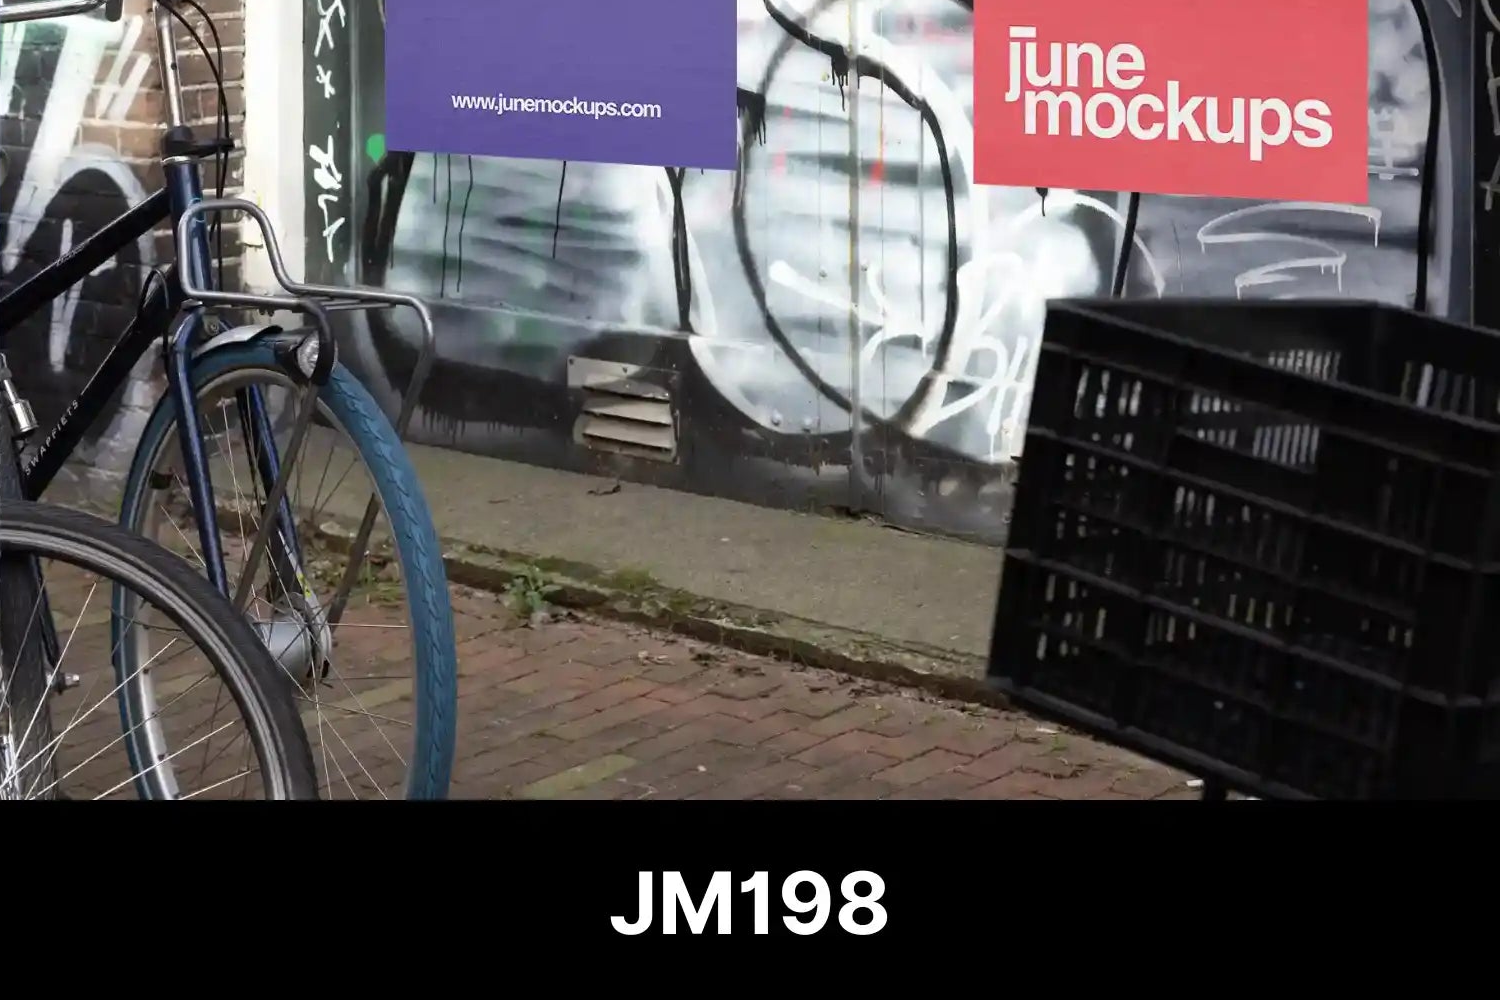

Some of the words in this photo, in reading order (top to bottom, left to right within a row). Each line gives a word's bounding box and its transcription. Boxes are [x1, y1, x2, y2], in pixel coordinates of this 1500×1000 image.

[1005, 26, 1145, 101] june
[452, 94, 661, 119] www.junemockups.com
[1025, 81, 1332, 160] mockups
[24, 399, 79, 475] SWAPFIETS
